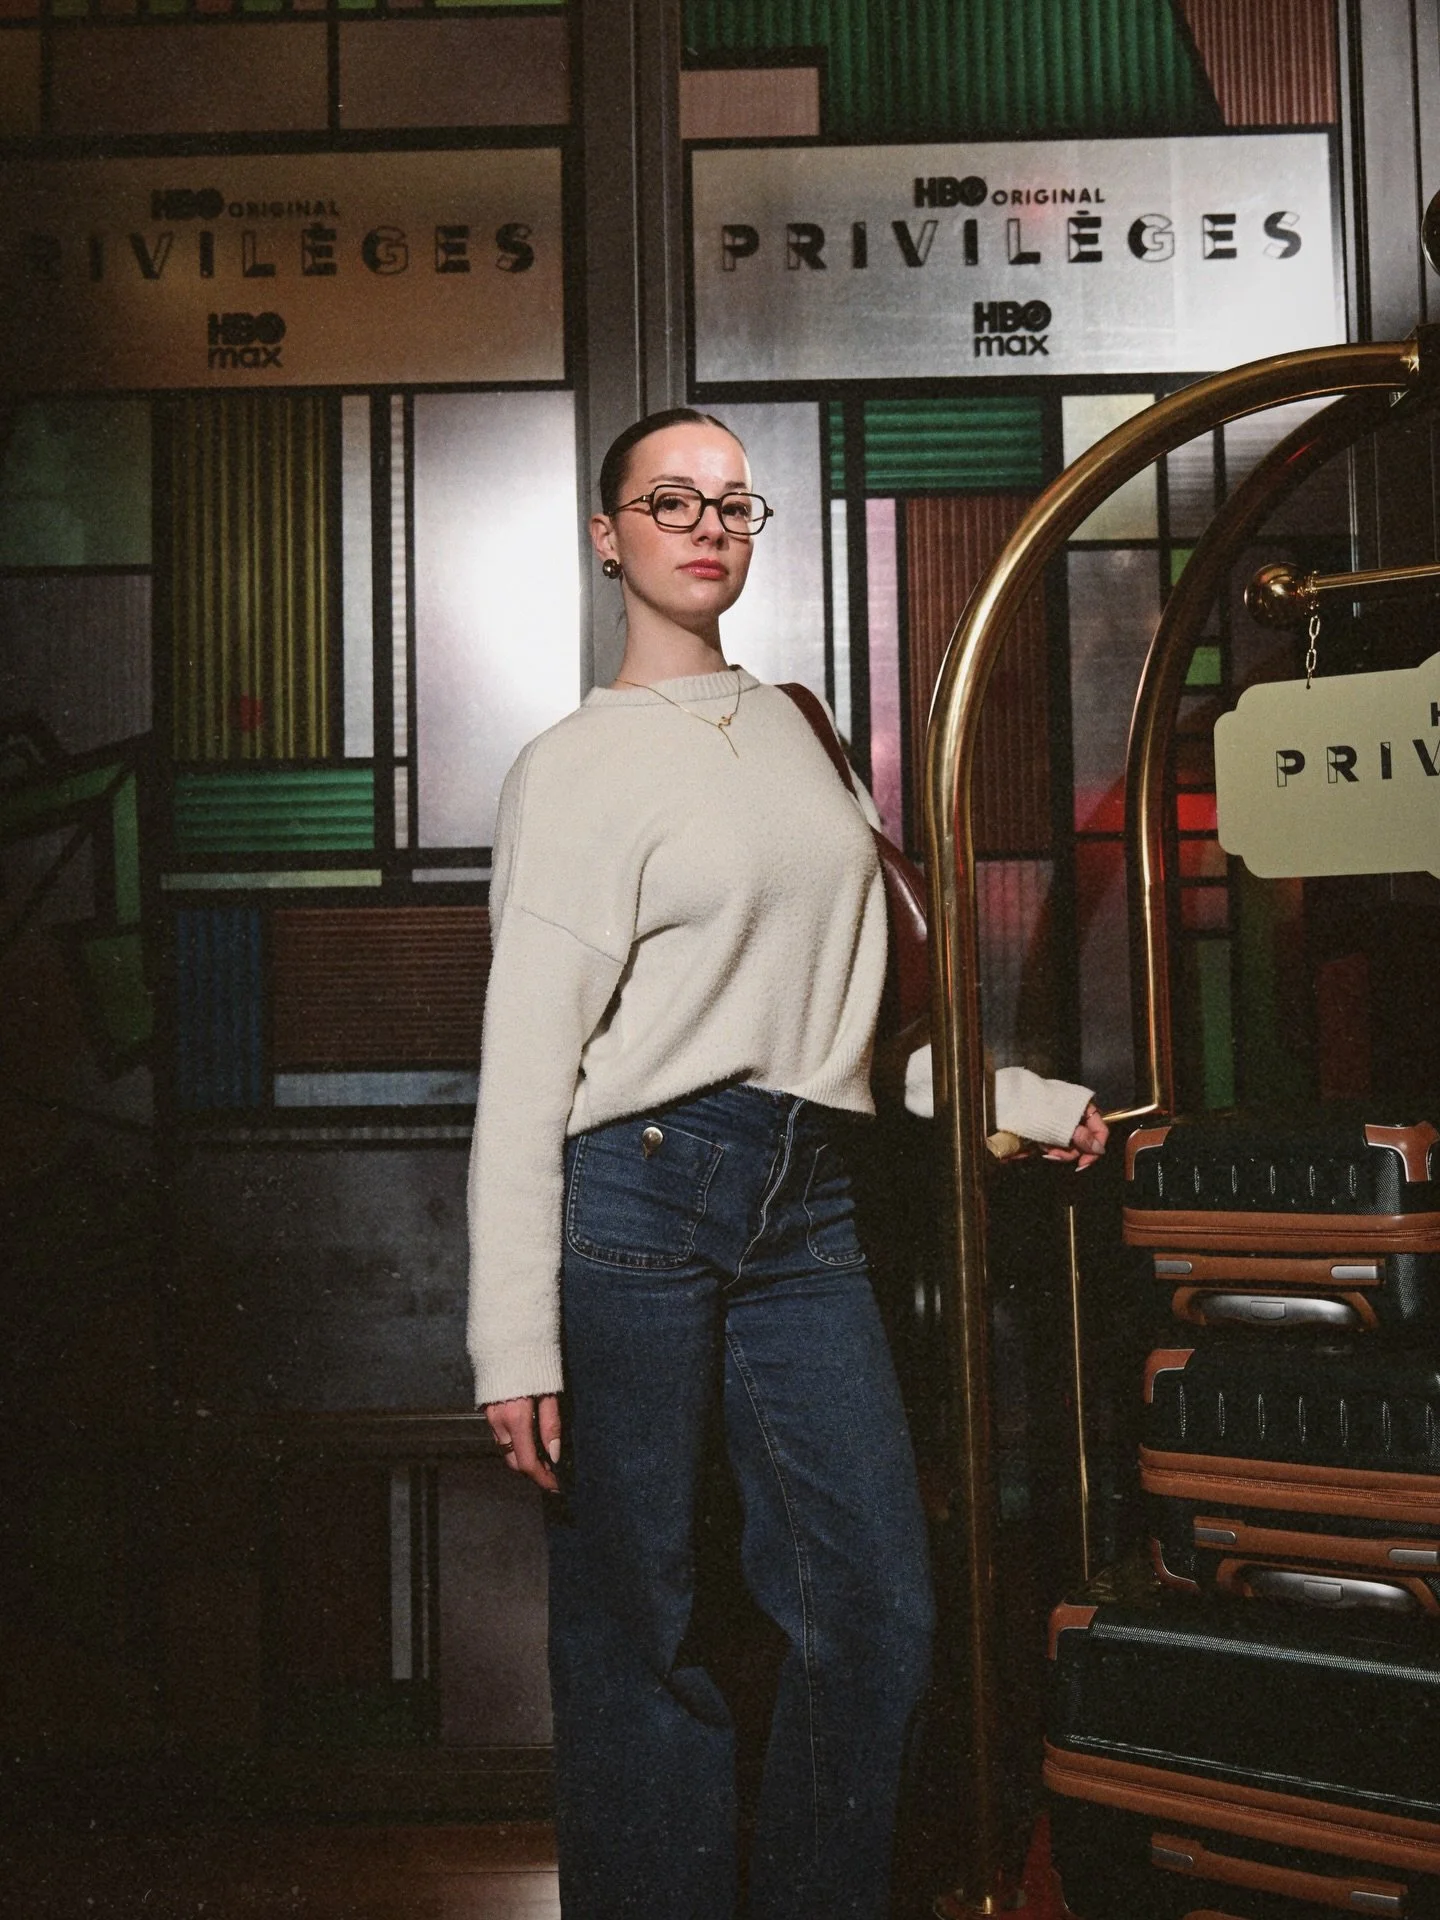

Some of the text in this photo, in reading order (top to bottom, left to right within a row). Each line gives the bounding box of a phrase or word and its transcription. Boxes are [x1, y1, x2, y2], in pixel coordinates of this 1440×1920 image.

[151, 188, 340, 220] HBO ORIGINAL
[914, 176, 1106, 208] HBO ORIGINAL
[207, 312, 286, 345] HBO
[973, 300, 1052, 334] HBO
[208, 346, 283, 370] max
[974, 334, 1049, 357] max
